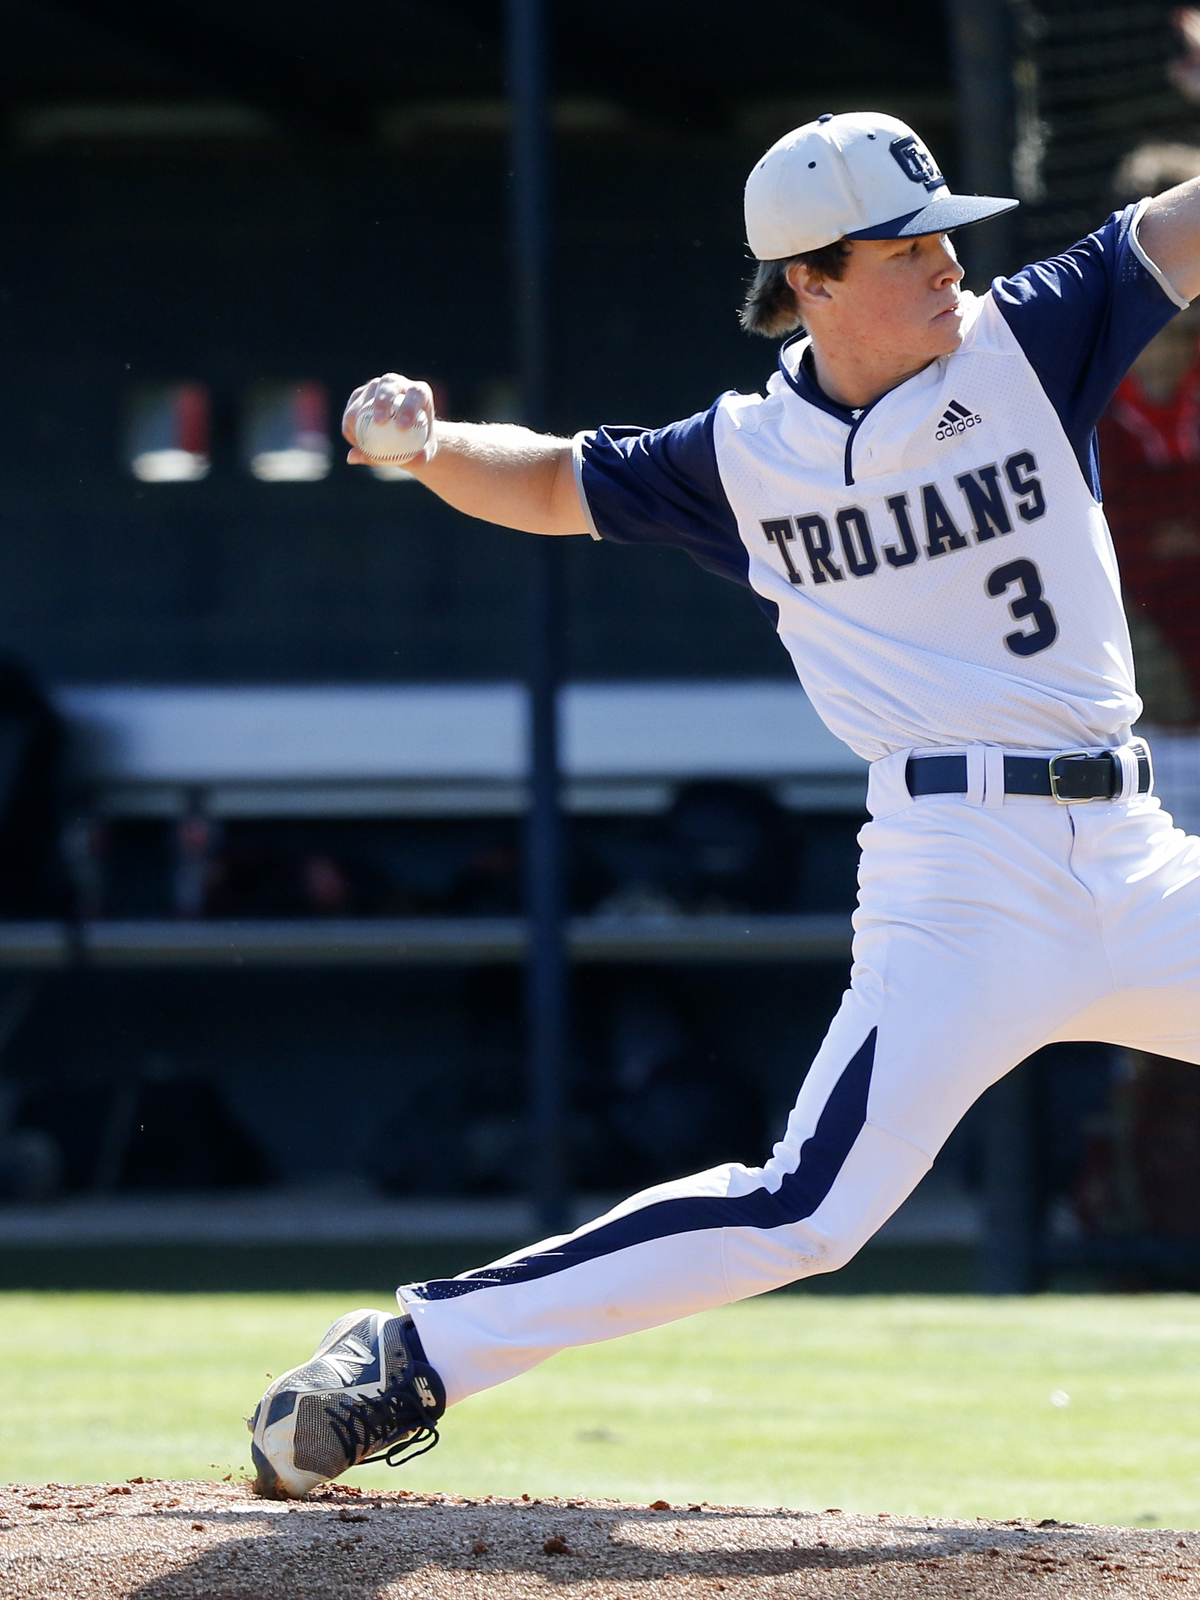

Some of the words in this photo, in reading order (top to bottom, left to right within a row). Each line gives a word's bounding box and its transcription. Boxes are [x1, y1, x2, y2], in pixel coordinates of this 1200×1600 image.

[935, 414, 982, 441] adidas
[758, 448, 1047, 587] TROJANS
[983, 557, 1060, 659] 3
